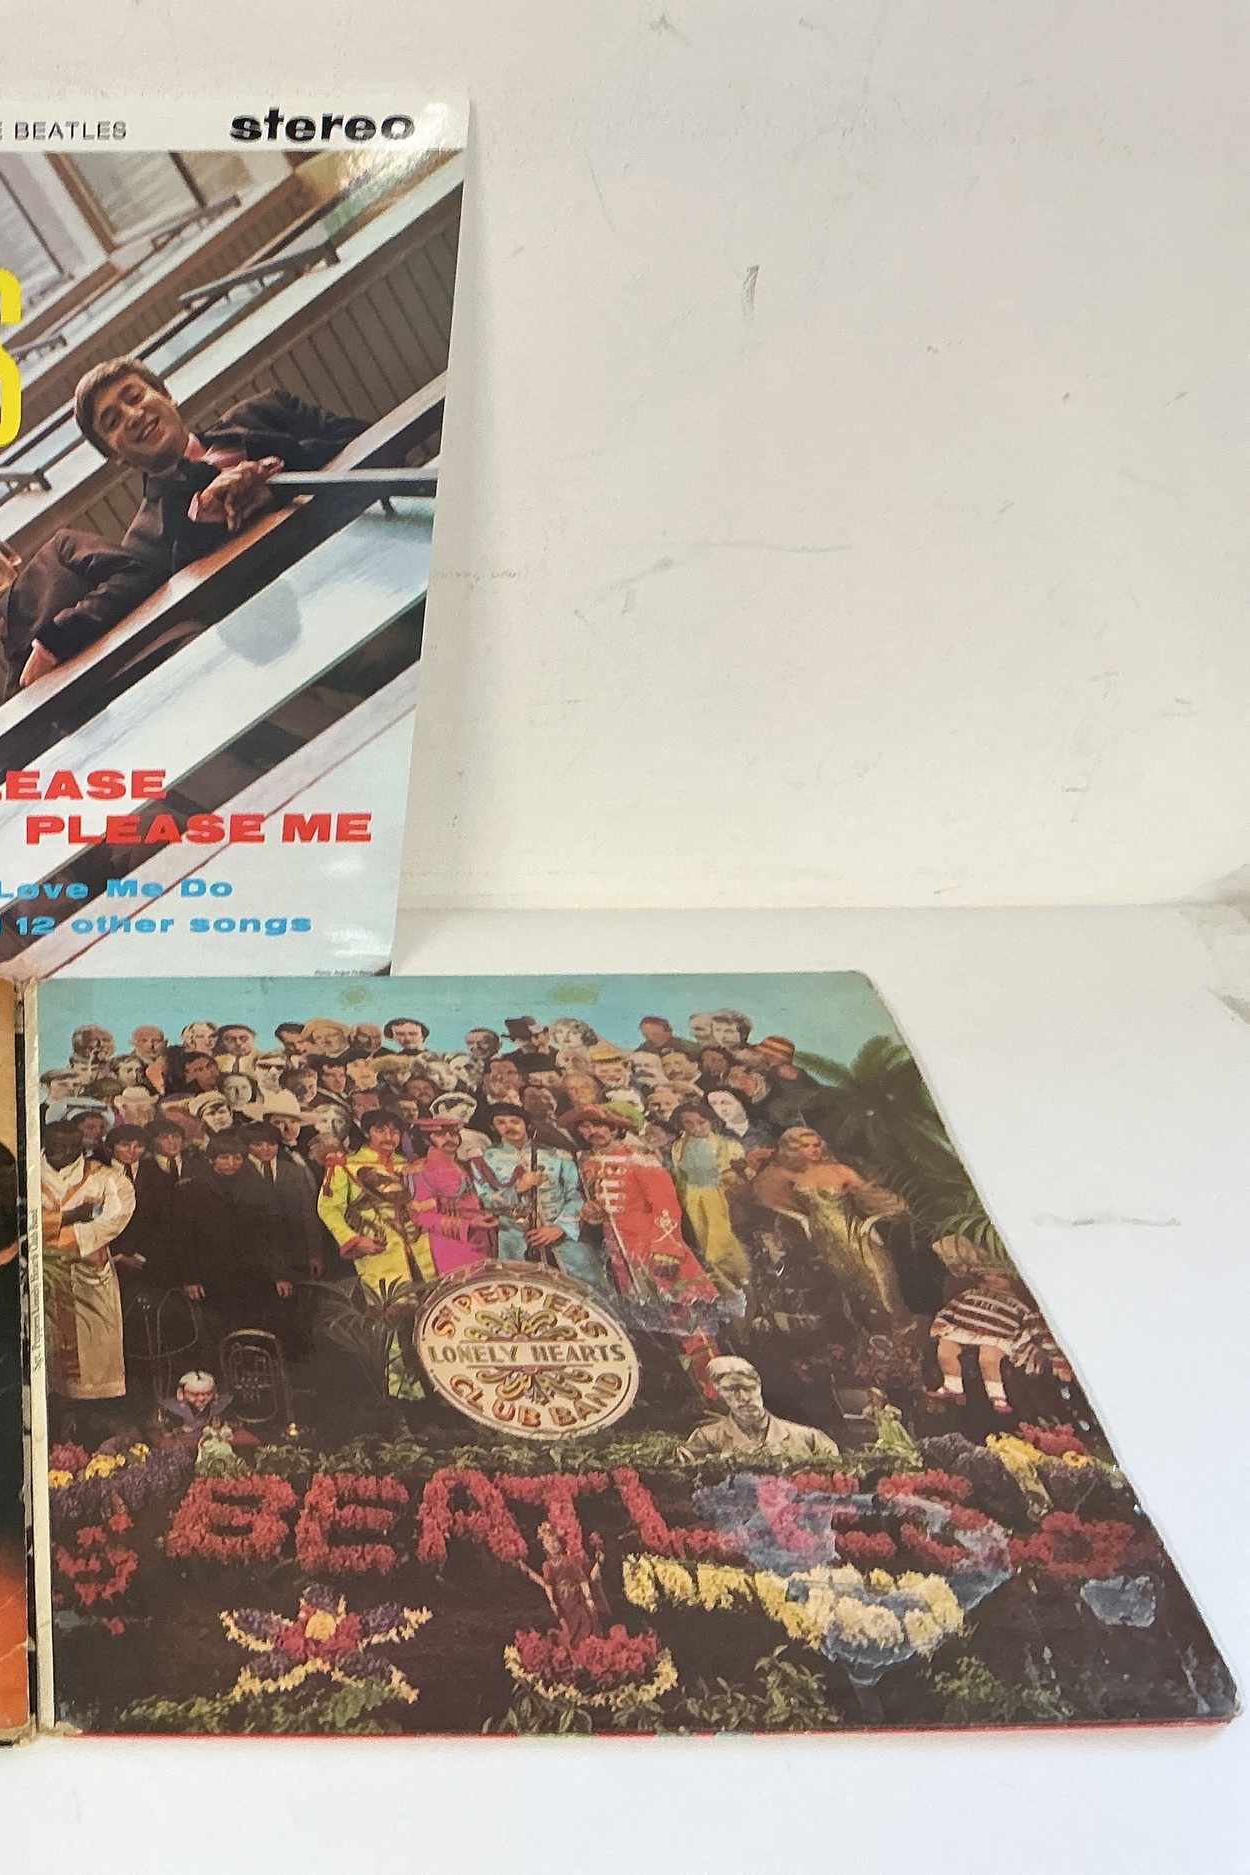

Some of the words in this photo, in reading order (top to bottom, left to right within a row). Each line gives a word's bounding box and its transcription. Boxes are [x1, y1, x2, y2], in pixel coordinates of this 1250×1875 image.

[14, 120, 127, 141] BEATLES
[230, 106, 415, 143] stereo
[25, 813, 265, 845] PLEASE
[281, 812, 373, 843] ME
[106, 879, 164, 899] Me
[180, 878, 234, 899] Do
[16, 916, 56, 936] 12
[71, 914, 175, 935] other
[189, 915, 312, 936] songs
[427, 1345, 519, 1364] LONELY
[531, 1344, 627, 1363] HEARTS
[449, 1373, 542, 1427] CLUB
[548, 1371, 623, 1427] BAND
[166, 1463, 1010, 1577] BEATLES
